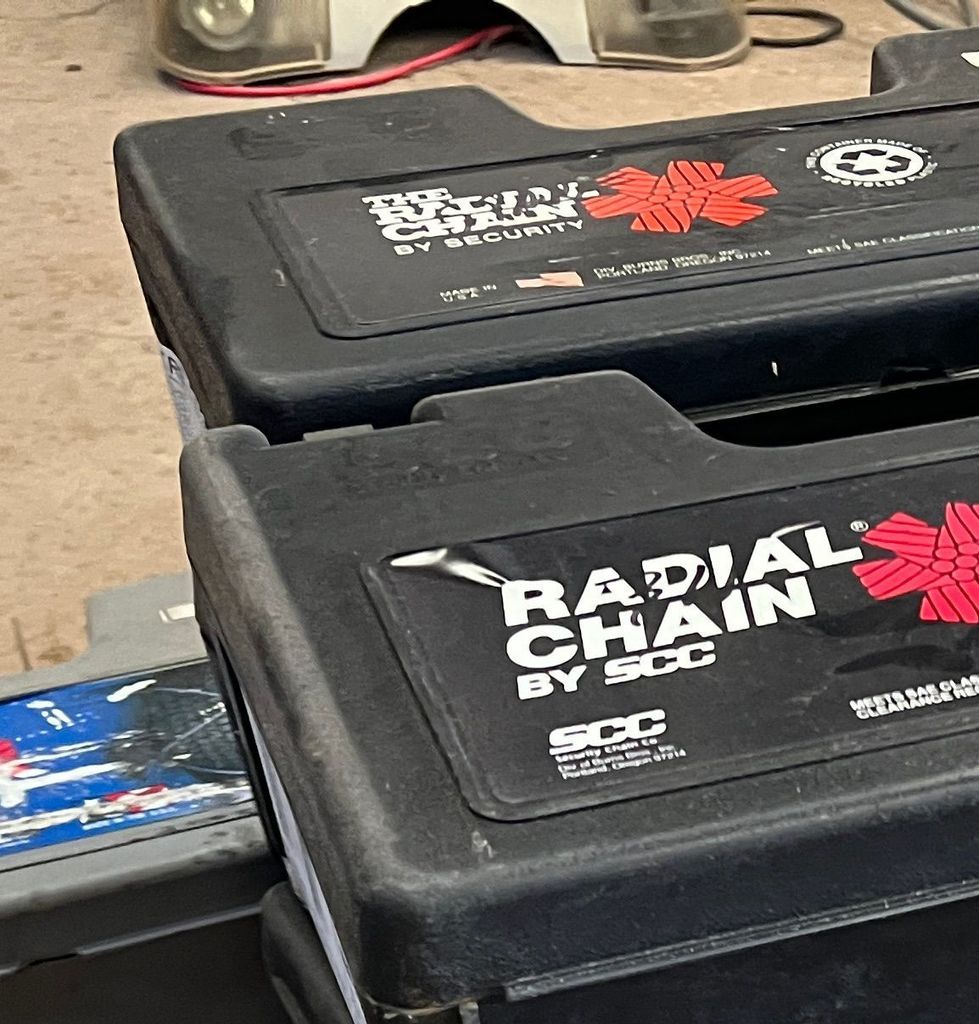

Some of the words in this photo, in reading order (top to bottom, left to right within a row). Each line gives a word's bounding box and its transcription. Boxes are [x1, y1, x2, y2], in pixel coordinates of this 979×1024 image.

[362, 187, 452, 209] THE
[393, 241, 432, 256] BY
[443, 219, 584, 248] SECURITY
[501, 526, 864, 627] RADIAL
[505, 575, 817, 669] CHAIN
[516, 664, 587, 700] BY
[603, 640, 717, 686] SCC
[850, 690, 904, 711] MEETS
[905, 683, 941, 699] SAE
[855, 691, 954, 720] CLEARANCE
[548, 708, 667, 756] SCC
